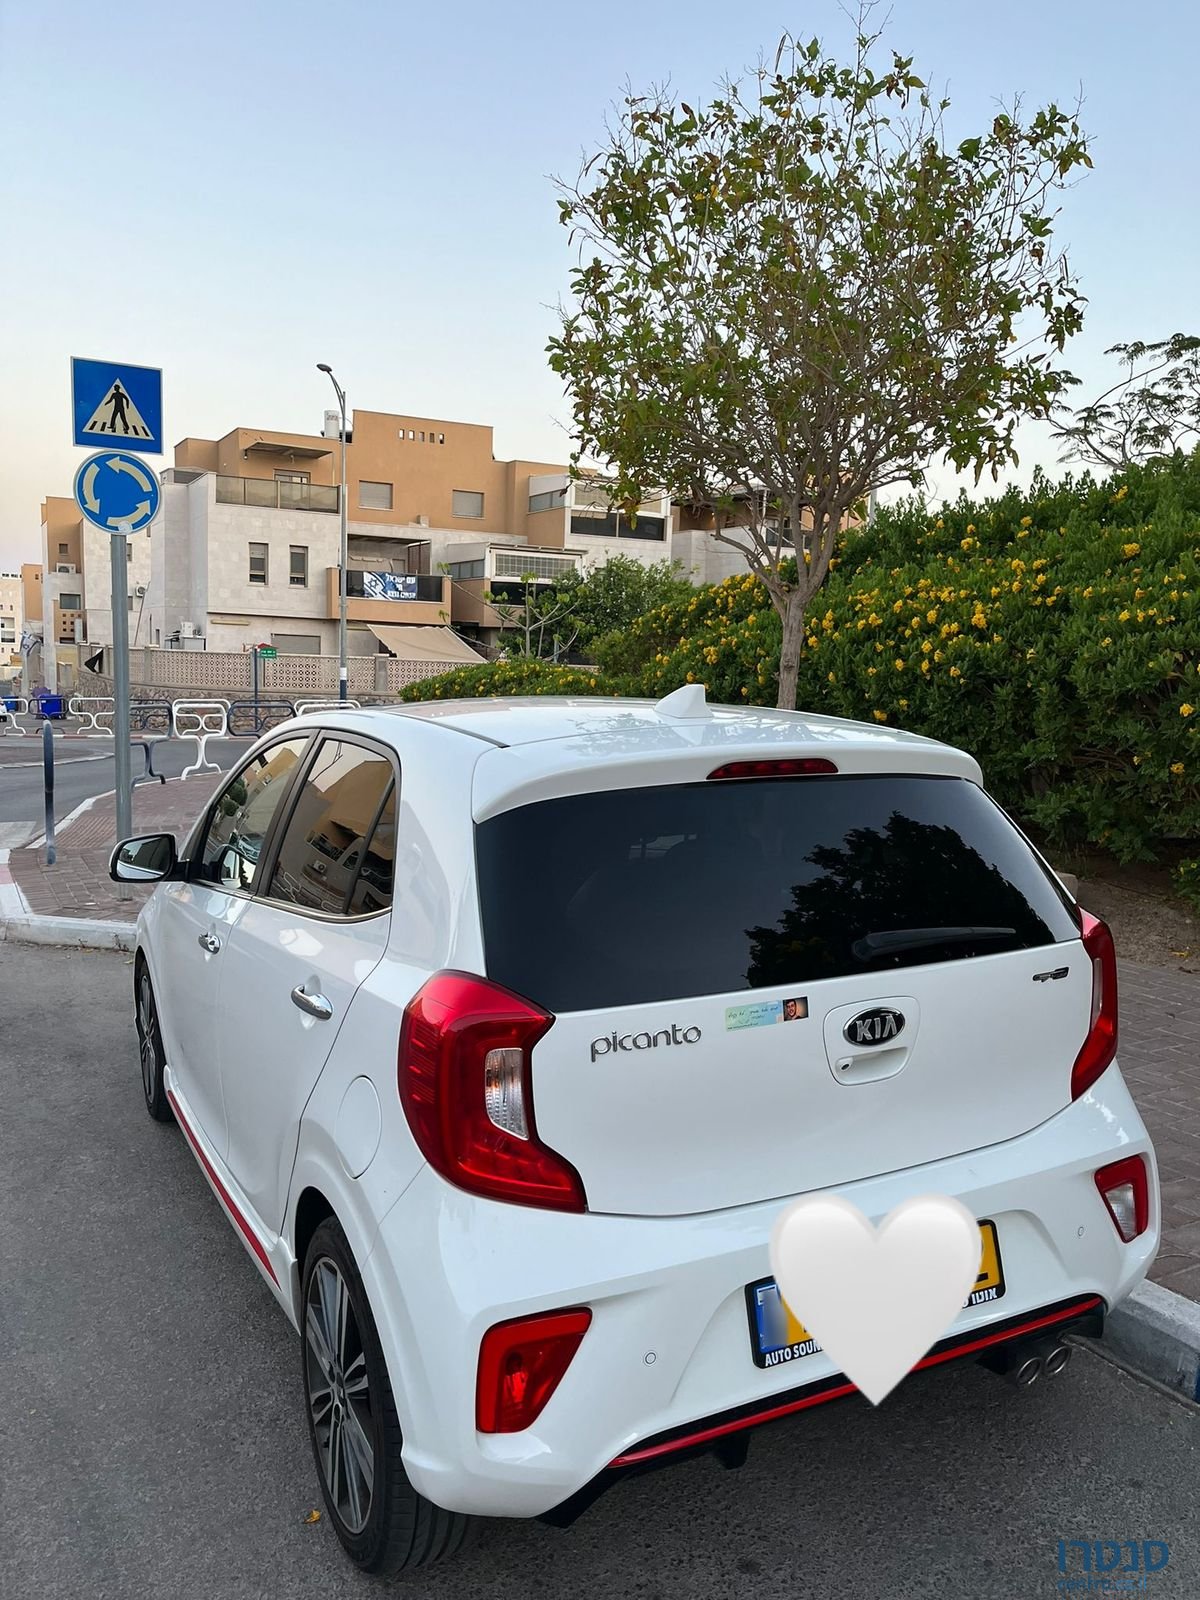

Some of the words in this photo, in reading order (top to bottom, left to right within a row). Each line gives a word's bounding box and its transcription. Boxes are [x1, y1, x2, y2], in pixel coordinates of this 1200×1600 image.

[855, 1013, 898, 1042] KIA
[590, 1023, 702, 1063] picanto
[765, 1347, 792, 1367] AUTO
[793, 1339, 821, 1358] SOUN
